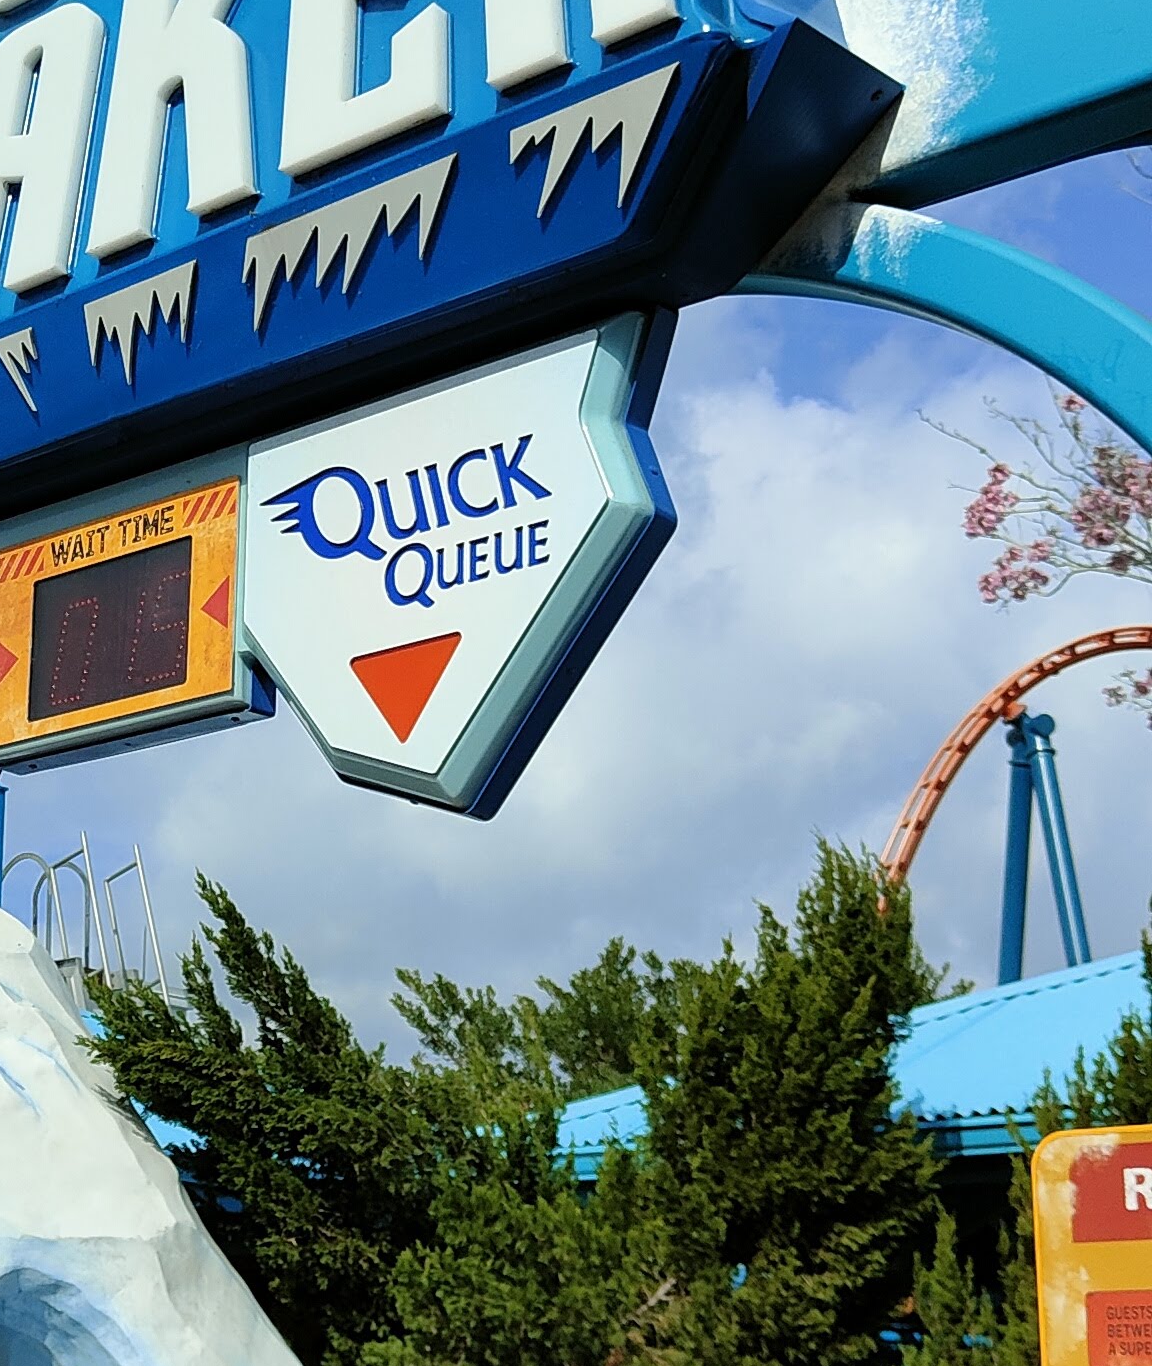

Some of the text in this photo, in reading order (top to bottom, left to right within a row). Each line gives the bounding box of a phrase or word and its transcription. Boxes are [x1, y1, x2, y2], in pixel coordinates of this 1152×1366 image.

[260, 433, 552, 560] QUICK
[50, 503, 175, 568] WAIT TIME
[384, 519, 551, 608] QUEUE
[1106, 1306, 1152, 1320] GUESTS
[1107, 1323, 1152, 1338] BETWE
[1108, 1341, 1152, 1356] A SUPE
